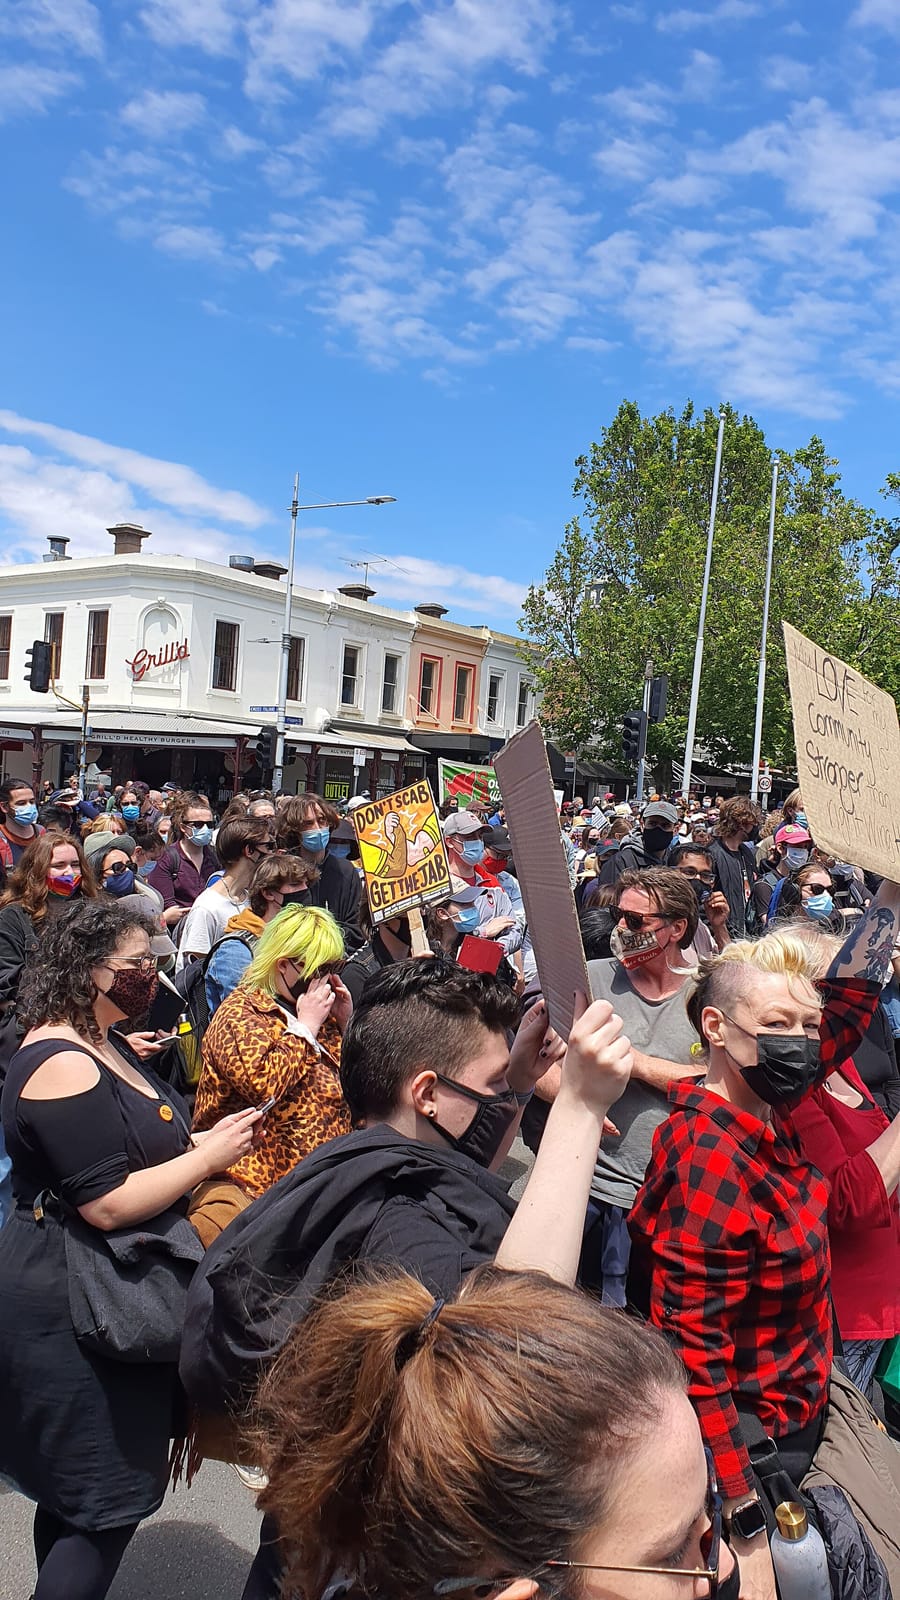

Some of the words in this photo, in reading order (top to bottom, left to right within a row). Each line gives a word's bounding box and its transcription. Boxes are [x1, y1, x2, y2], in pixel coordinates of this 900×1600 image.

[125, 637, 191, 681] Grill'd
[814, 649, 859, 716] LOVE
[91, 733, 121, 741] GRILL'D
[123, 735, 158, 743] HEALTHY
[160, 736, 196, 744] BURGERS
[808, 702, 876, 786] Community
[325, 783, 350, 799] OUTLET
[355, 797, 394, 833] DON'T
[394, 784, 430, 808] SCAB
[370, 880, 398, 908] GET
[396, 872, 421, 896] THE
[417, 854, 447, 887] JAB
